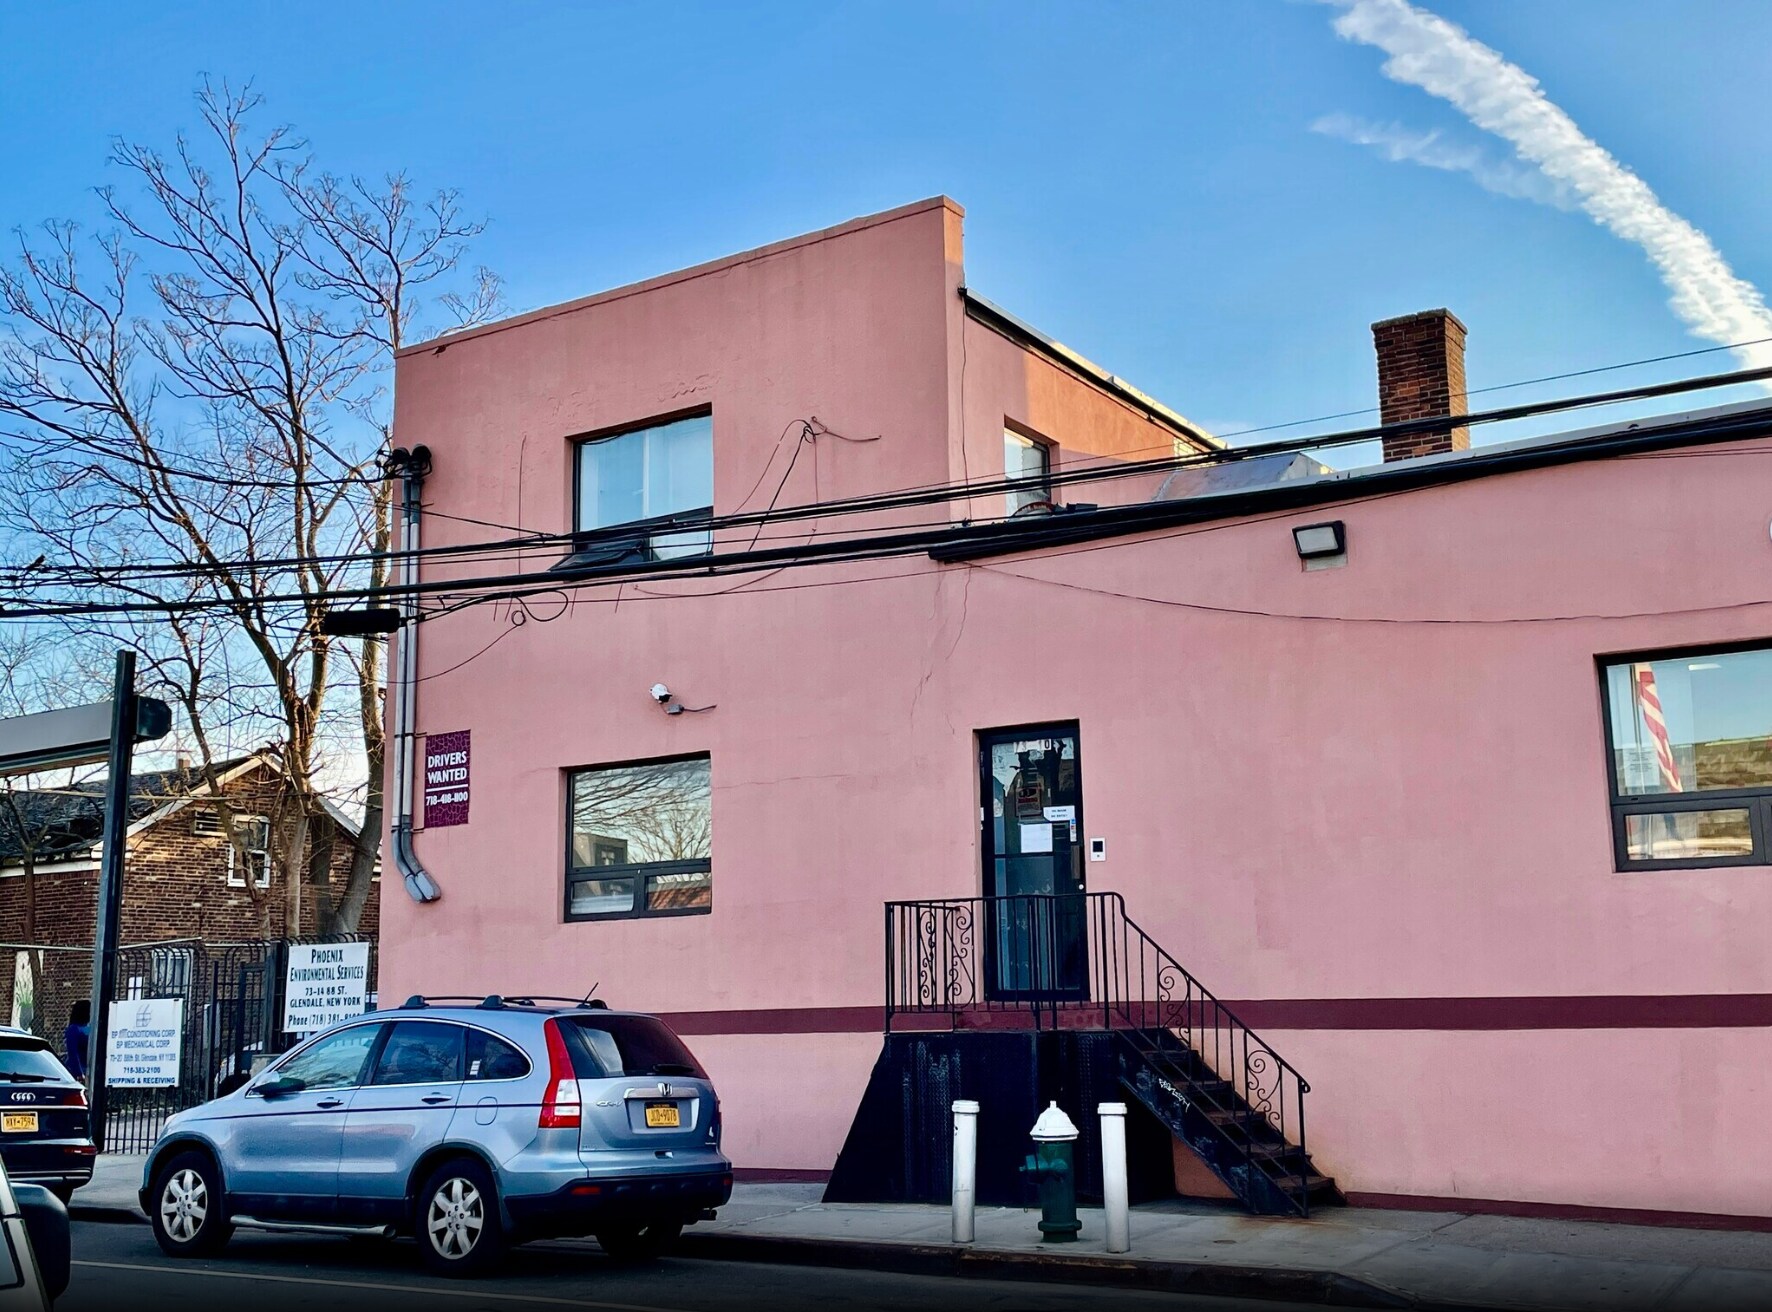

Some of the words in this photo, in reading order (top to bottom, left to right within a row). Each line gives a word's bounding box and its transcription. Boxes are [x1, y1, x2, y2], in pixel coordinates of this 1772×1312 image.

[428, 751, 467, 768] DRIVERS
[428, 768, 467, 784] WANTED
[426, 791, 468, 806] 718-418-1100
[312, 949, 343, 963] PHOENIX
[290, 967, 335, 982] ENVIRONMENTAL
[337, 965, 364, 980] SERVICES
[305, 987, 324, 996] 73-14
[326, 987, 335, 995] 88
[337, 986, 347, 995] ST.
[326, 998, 340, 1007] NEW
[343, 997, 361, 1006] YORK
[288, 1014, 308, 1028] Phone
[309, 1014, 326, 1027] (718)
[124, 1040, 155, 1048] MECHANICAL
